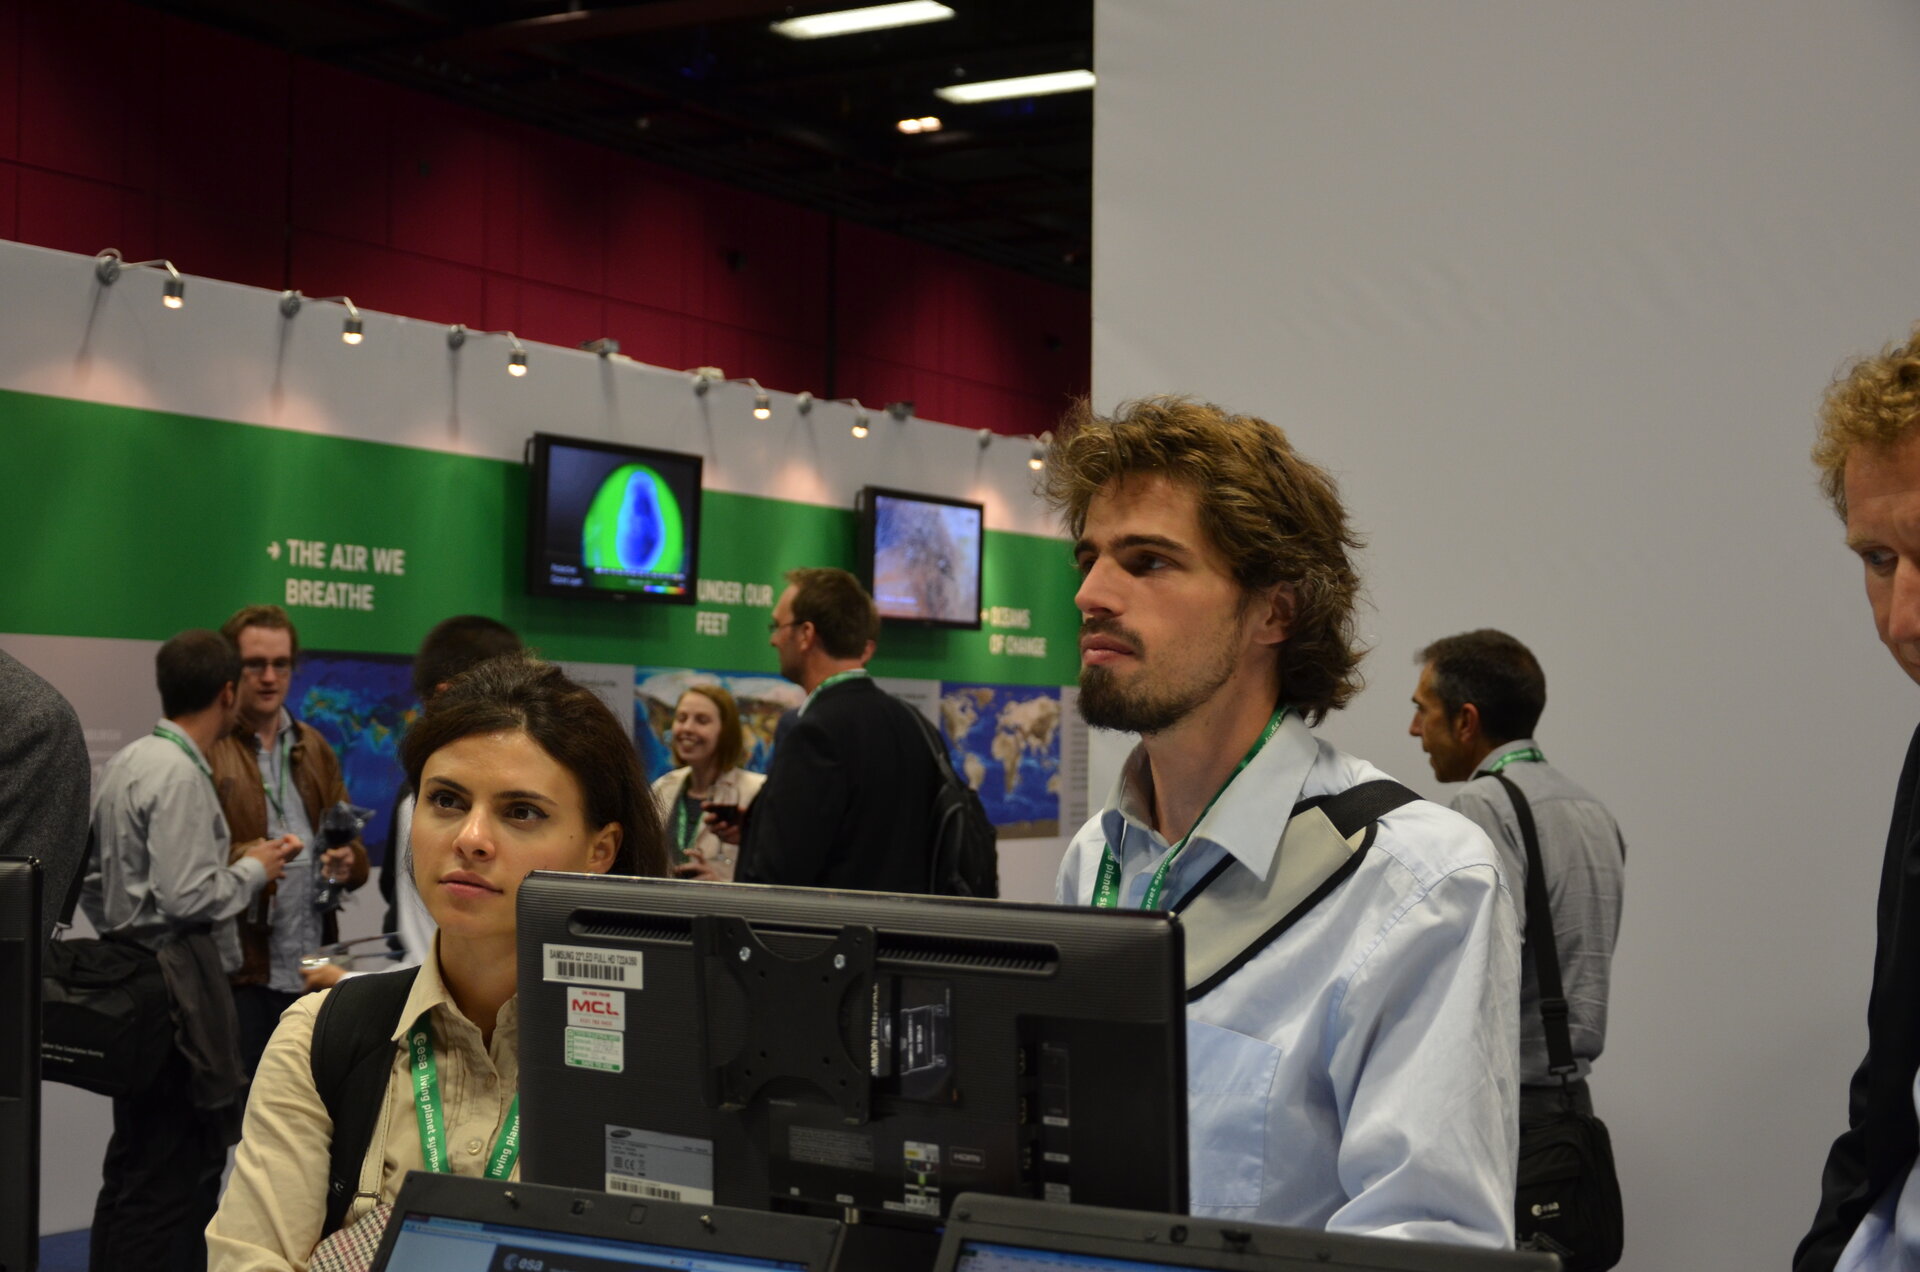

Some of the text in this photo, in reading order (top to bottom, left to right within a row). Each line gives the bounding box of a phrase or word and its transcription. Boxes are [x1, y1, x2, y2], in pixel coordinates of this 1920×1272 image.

[286, 538, 405, 575] THE AIR WE
[285, 578, 375, 611] BREATHE
[744, 583, 773, 607] OUR
[696, 611, 730, 636] FEET
[989, 633, 1047, 658] OF CHANGE
[1101, 863, 1115, 899] planet
[550, 949, 574, 961] SAMSUNG
[594, 953, 606, 964] FULL
[608, 955, 615, 965] HD
[572, 999, 619, 1016] MCL
[419, 1074, 431, 1102] living
[421, 1102, 437, 1135] planet
[491, 1148, 513, 1176] living
